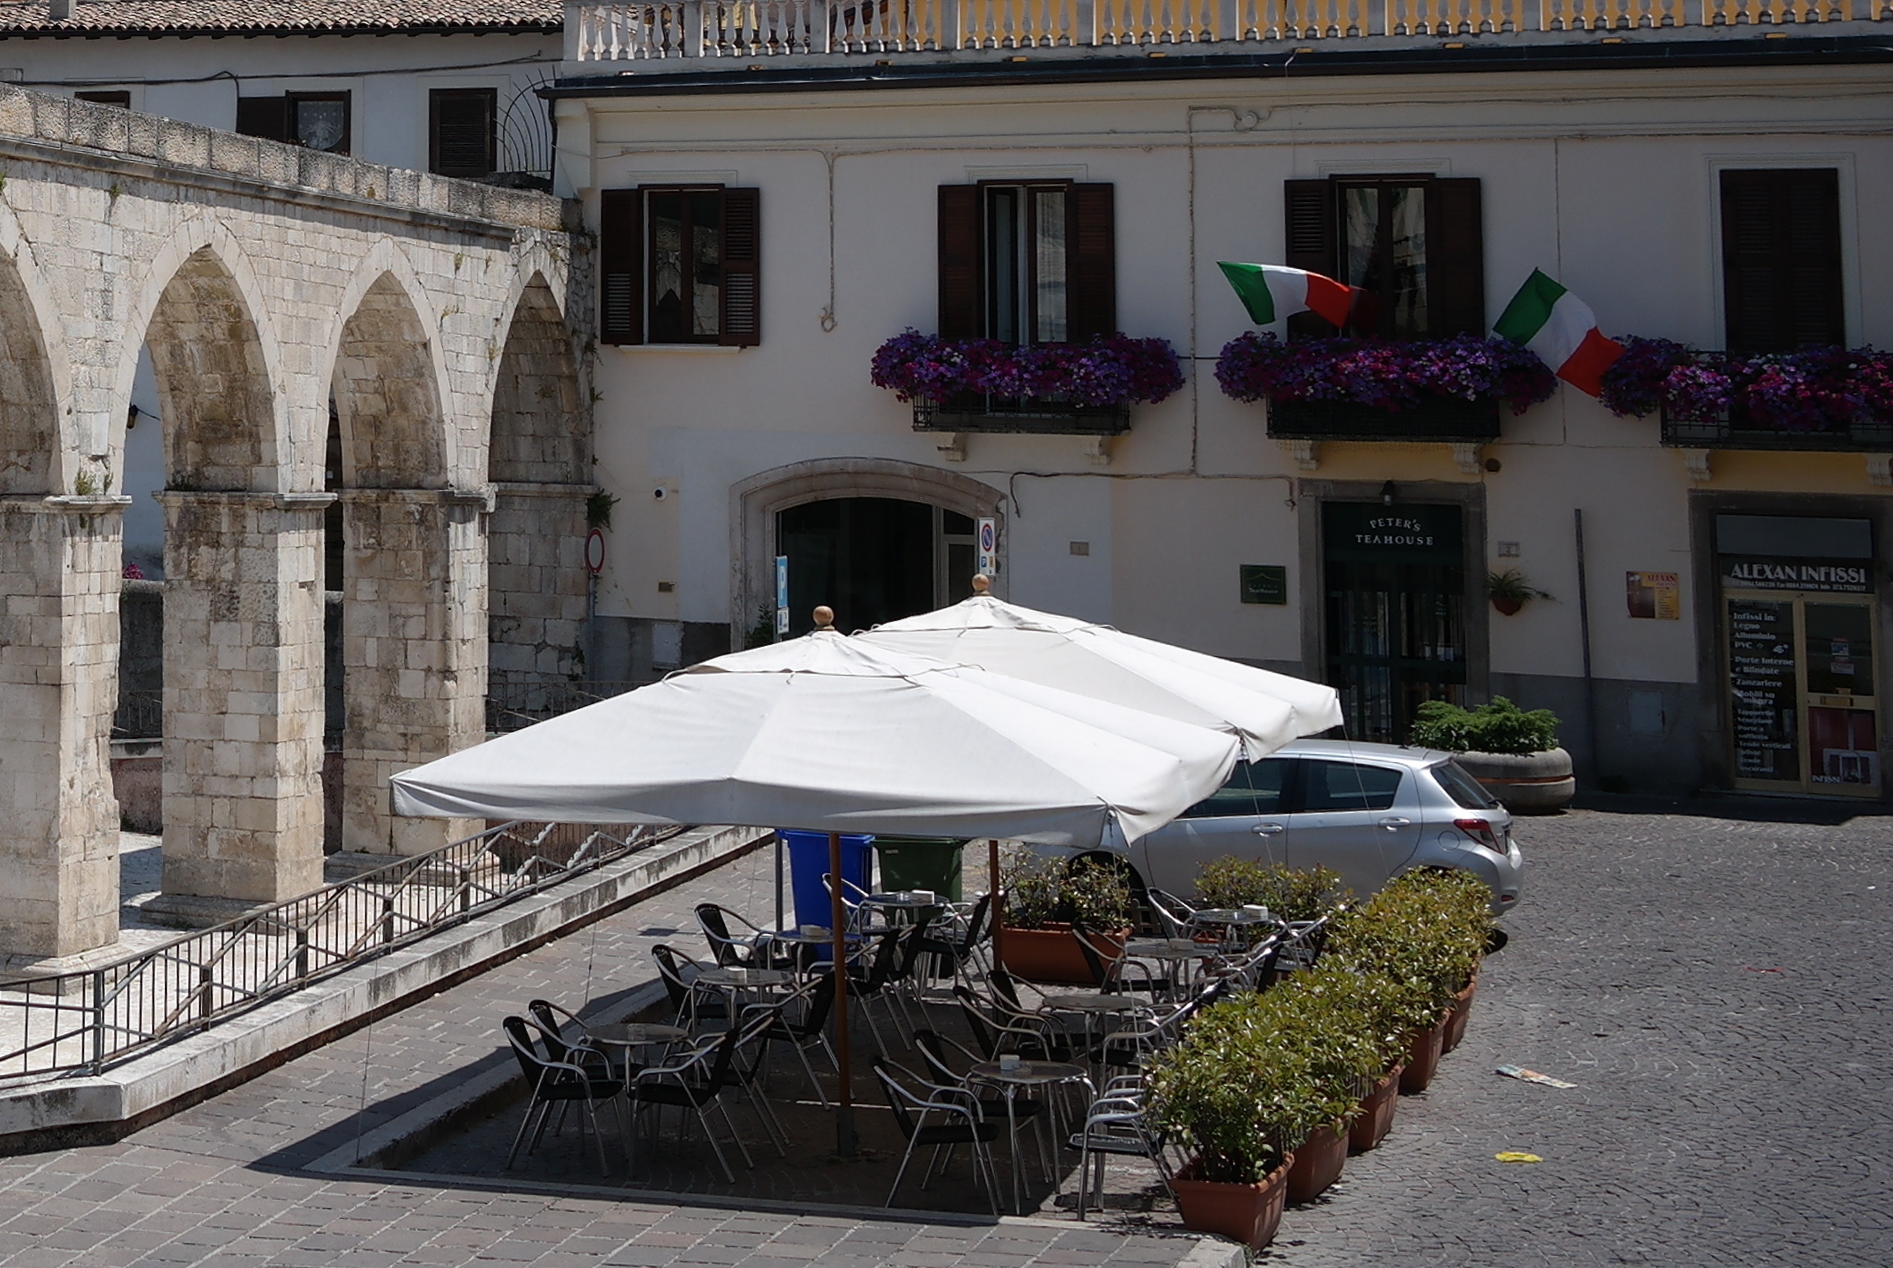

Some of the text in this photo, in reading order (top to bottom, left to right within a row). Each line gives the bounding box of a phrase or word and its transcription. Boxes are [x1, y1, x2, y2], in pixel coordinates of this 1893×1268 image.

[1369, 517, 1421, 532] PETER'S
[1355, 534, 1434, 546] TEAHOUSE
[1730, 563, 1866, 583] ALEXAN INFISSI
[1733, 622, 1760, 631] Legno
[1734, 641, 1753, 649] PVC
[1735, 656, 1760, 664] Porte
